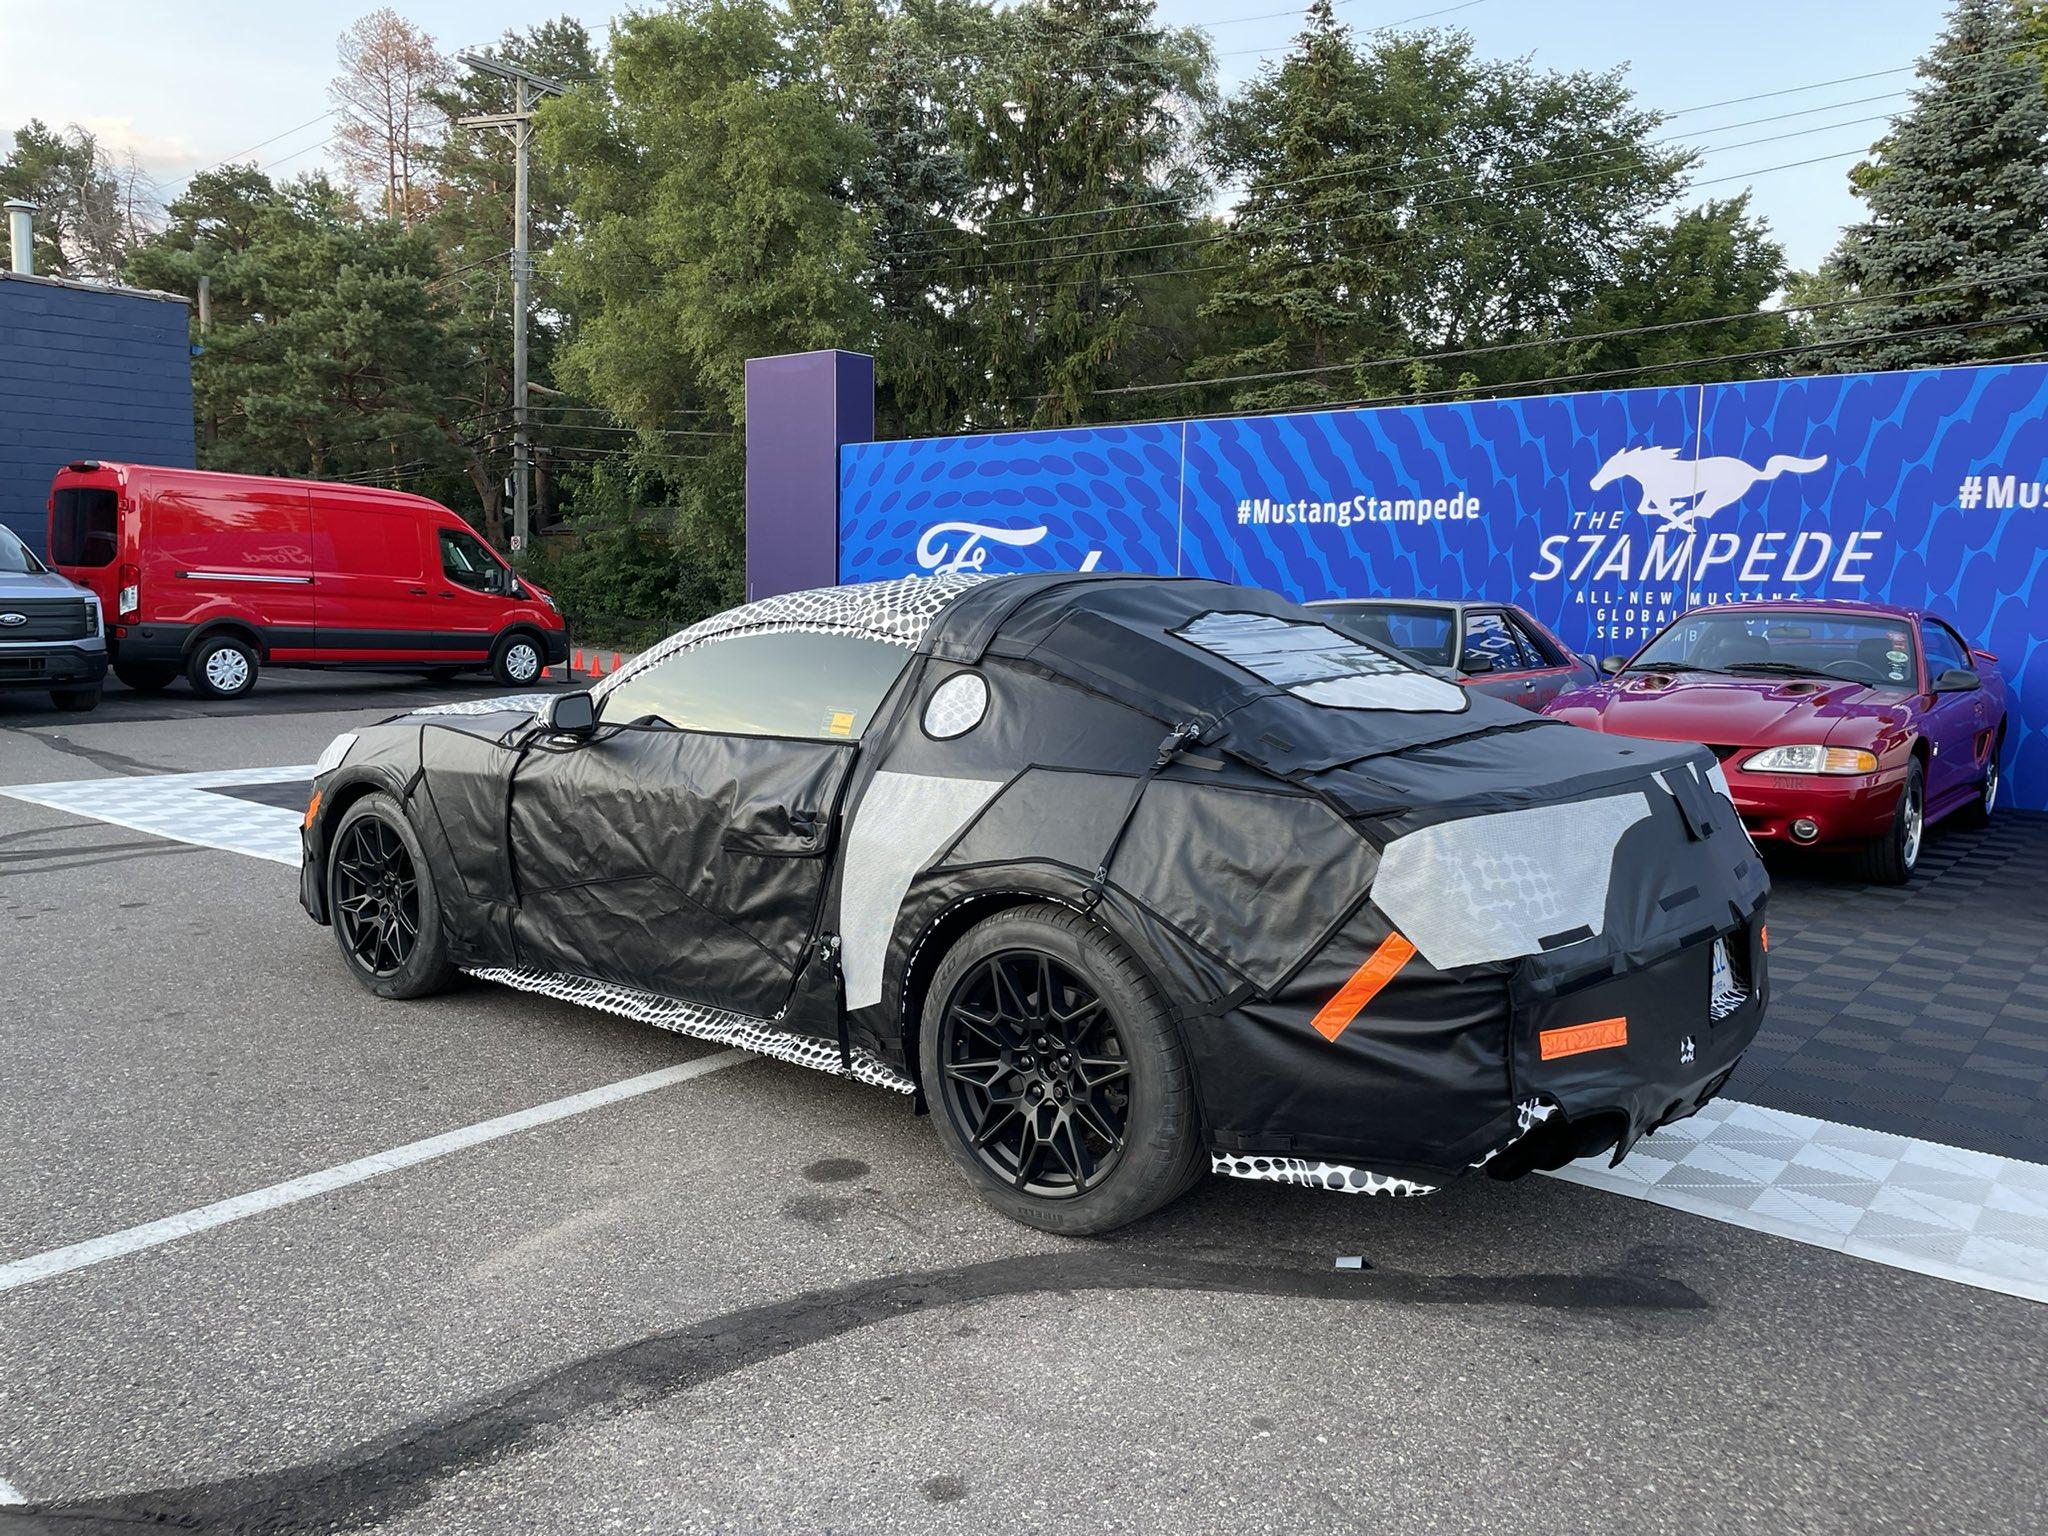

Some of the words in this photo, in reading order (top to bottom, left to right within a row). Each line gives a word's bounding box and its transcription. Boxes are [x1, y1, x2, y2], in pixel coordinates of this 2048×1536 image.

[1237, 491, 1481, 527] #MustangStampede
[1573, 511, 1625, 530] THE
[1529, 531, 1883, 582] S7AMPEDE
[1576, 591, 1673, 605] ALL-NEW
